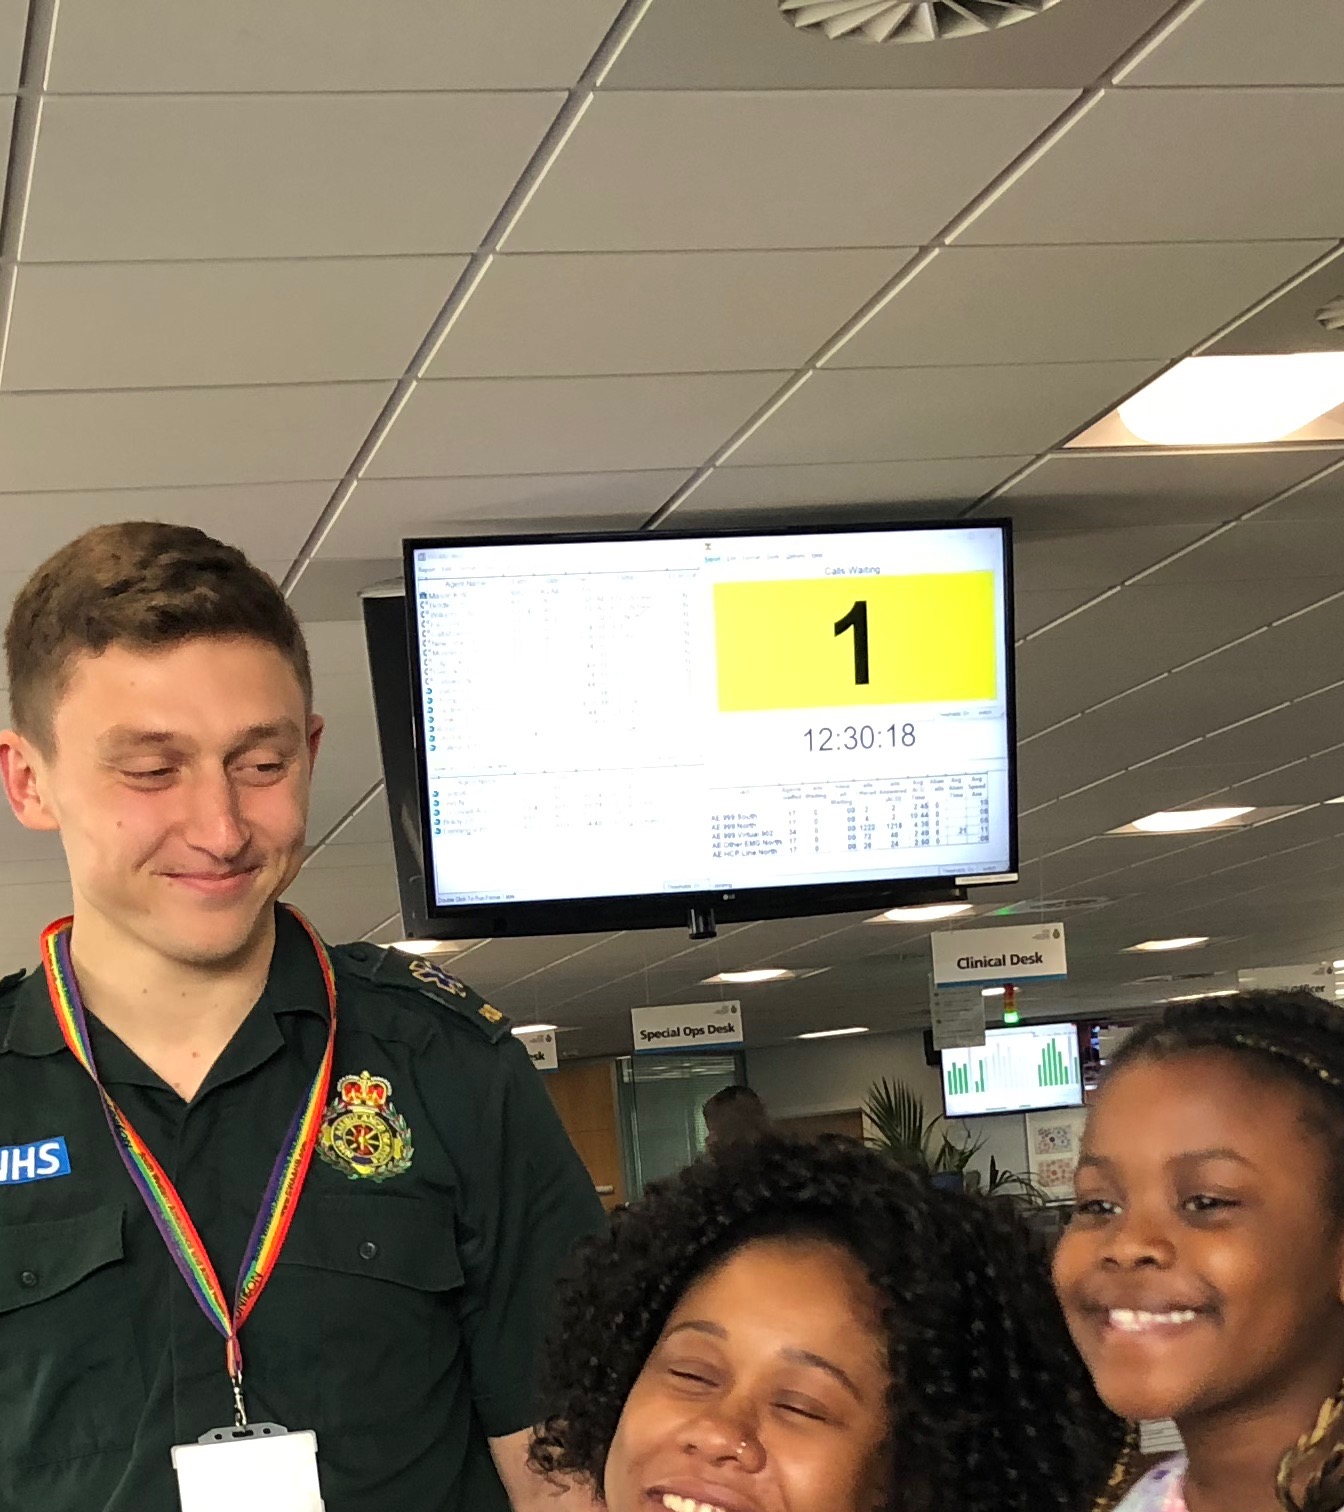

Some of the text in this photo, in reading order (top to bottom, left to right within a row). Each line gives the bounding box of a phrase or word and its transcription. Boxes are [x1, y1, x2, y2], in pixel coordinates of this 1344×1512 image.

[824, 565, 881, 577] Calls Waiting
[834, 600, 869, 686] 1
[803, 722, 916, 752] 12:30:18
[957, 951, 1043, 970] Clinical Desk
[639, 1022, 735, 1042] Special Ops Desk
[235, 1270, 263, 1319] UNISON
